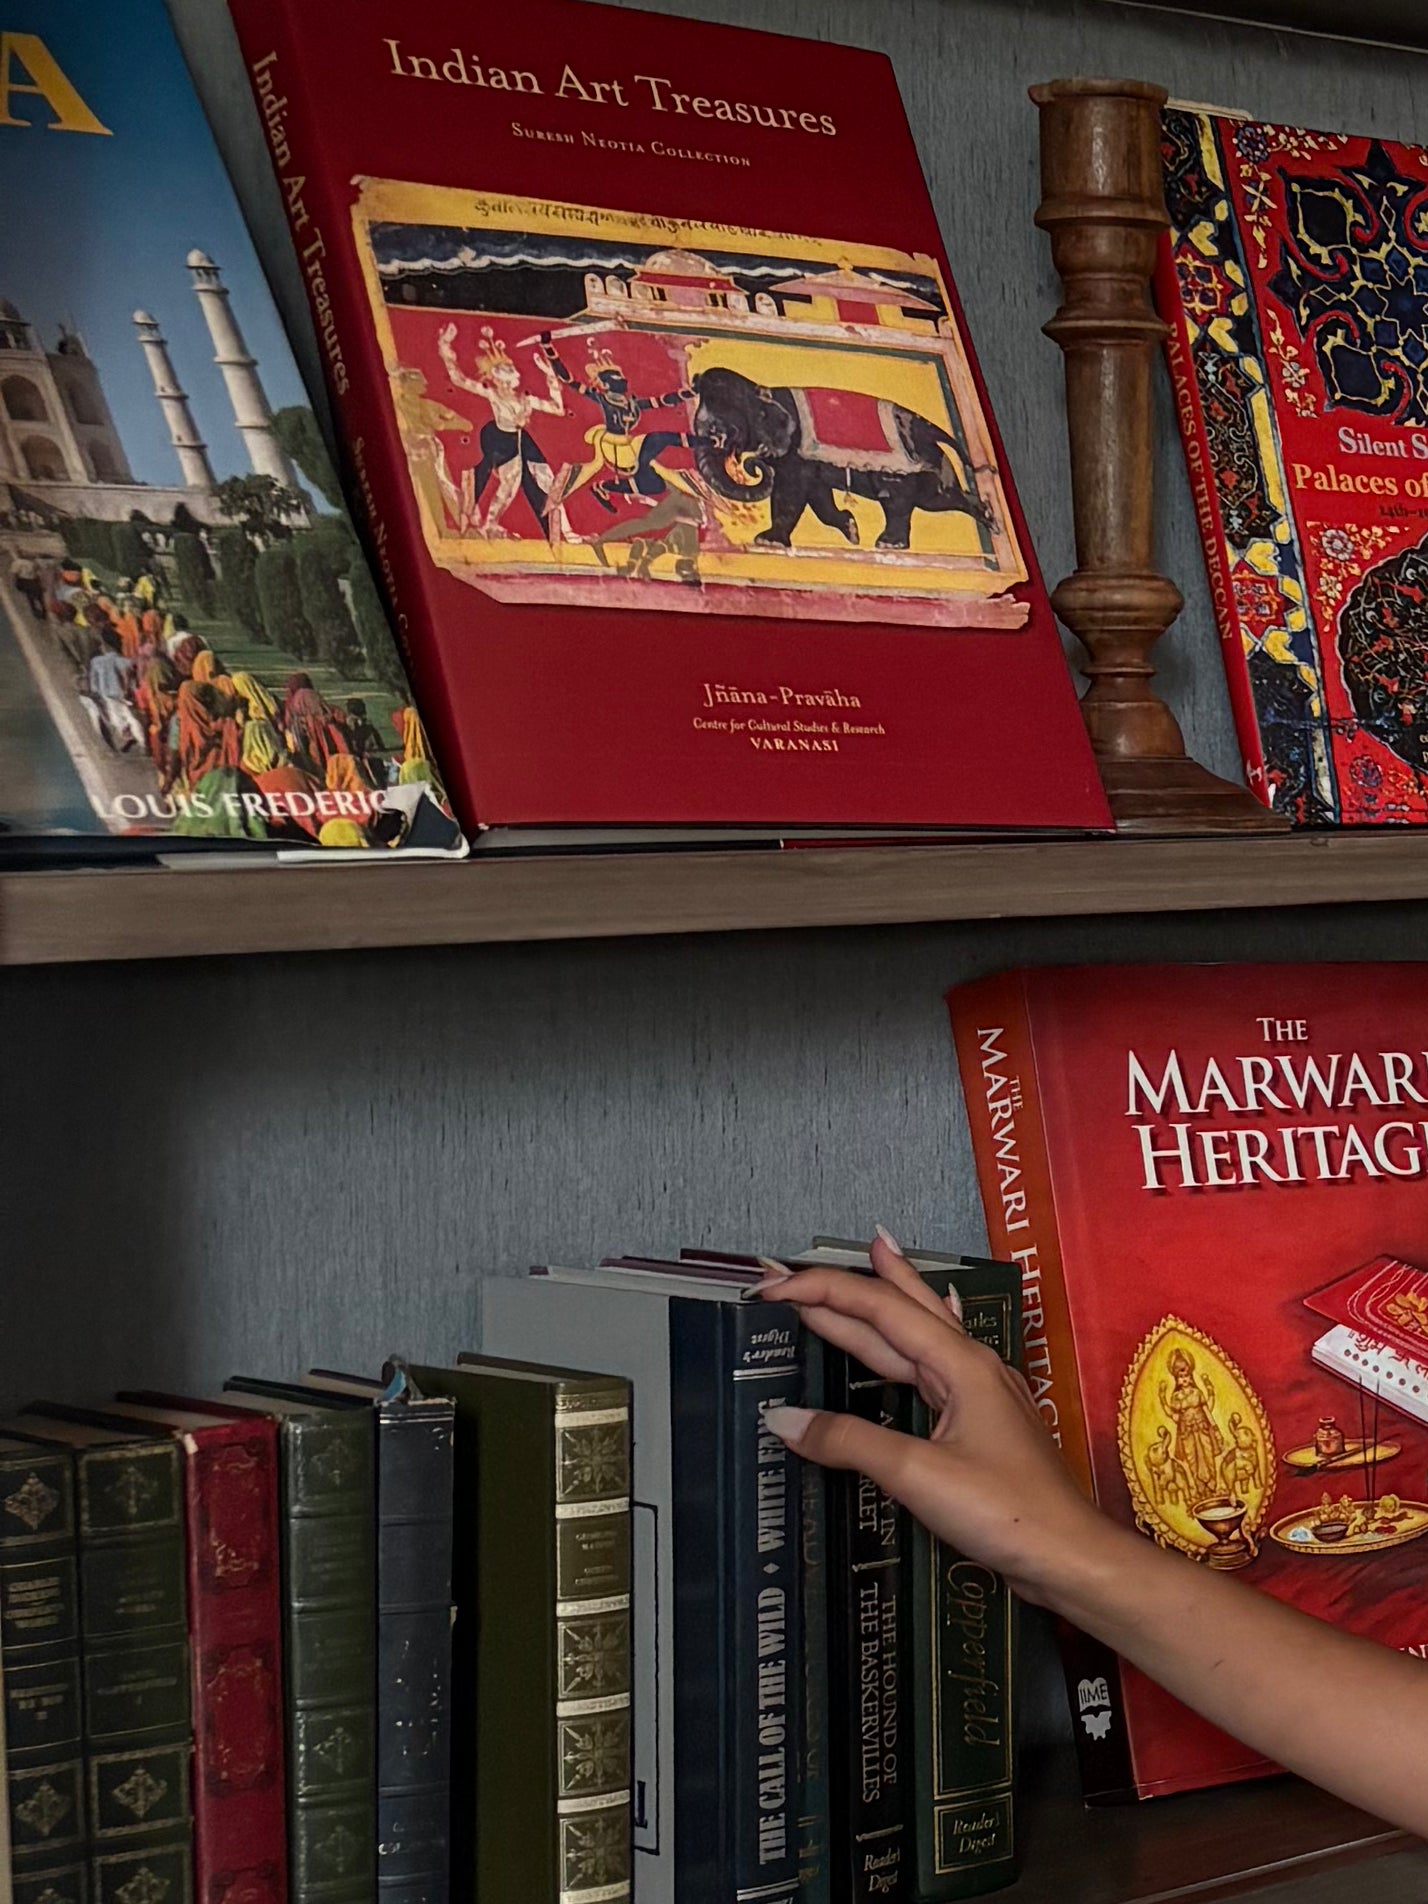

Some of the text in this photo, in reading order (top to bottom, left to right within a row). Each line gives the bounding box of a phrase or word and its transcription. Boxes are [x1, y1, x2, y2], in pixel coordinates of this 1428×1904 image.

[382, 38, 838, 136] Indian Art Treasures
[511, 121, 751, 167] SURESH NEOTIA COLLECTION
[252, 49, 351, 396] Indian Art Treasures
[1338, 427, 1407, 459] Silent
[1167, 321, 1234, 641] PALACES OF THE DECCAN
[1292, 463, 1398, 495] Palaces
[693, 717, 886, 735] Centre for Cultural Studies & Research
[750, 737, 839, 752] VARANASI
[99, 794, 212, 819] LOUIS
[1256, 1016, 1308, 1042] THE
[1009, 1075, 1024, 1110] THE
[977, 1027, 1030, 1234] MARWARI
[757, 1466, 787, 1553] WHITE
[757, 1586, 787, 1658] WILD
[946, 1559, 1001, 1747] Copperfield
[757, 1659, 787, 1711] THE
[860, 1582, 881, 1804] THE BASKERVILLES
[882, 1595, 898, 1785] THE HOUND OF
[1080, 1683, 1108, 1704] IIME
[757, 1712, 787, 1747] OF
[757, 1746, 787, 1810] CALL
[757, 1812, 787, 1865] THE
